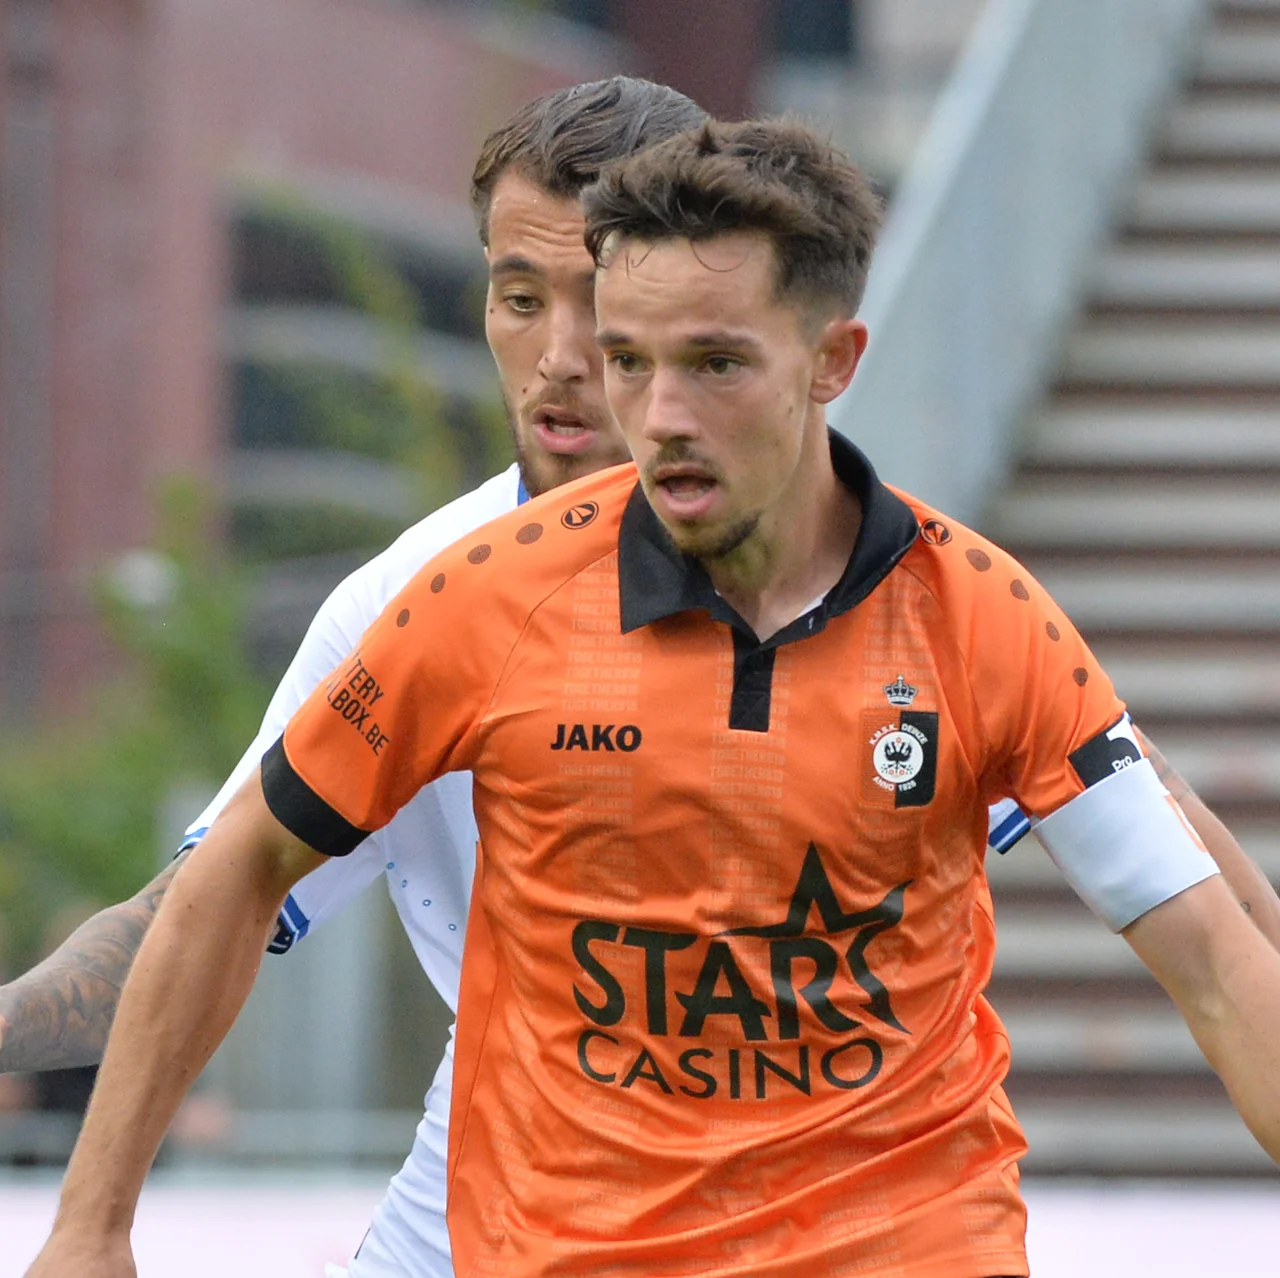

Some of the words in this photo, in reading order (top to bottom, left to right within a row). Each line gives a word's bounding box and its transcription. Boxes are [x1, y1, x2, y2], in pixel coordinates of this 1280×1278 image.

[550, 724, 642, 752] JAKO
[901, 722, 929, 746] DEINZE
[1111, 756, 1133, 773] Pro
[872, 775, 895, 791] ANNO
[570, 878, 913, 1041] STARS
[577, 1028, 884, 1100] CASINO
